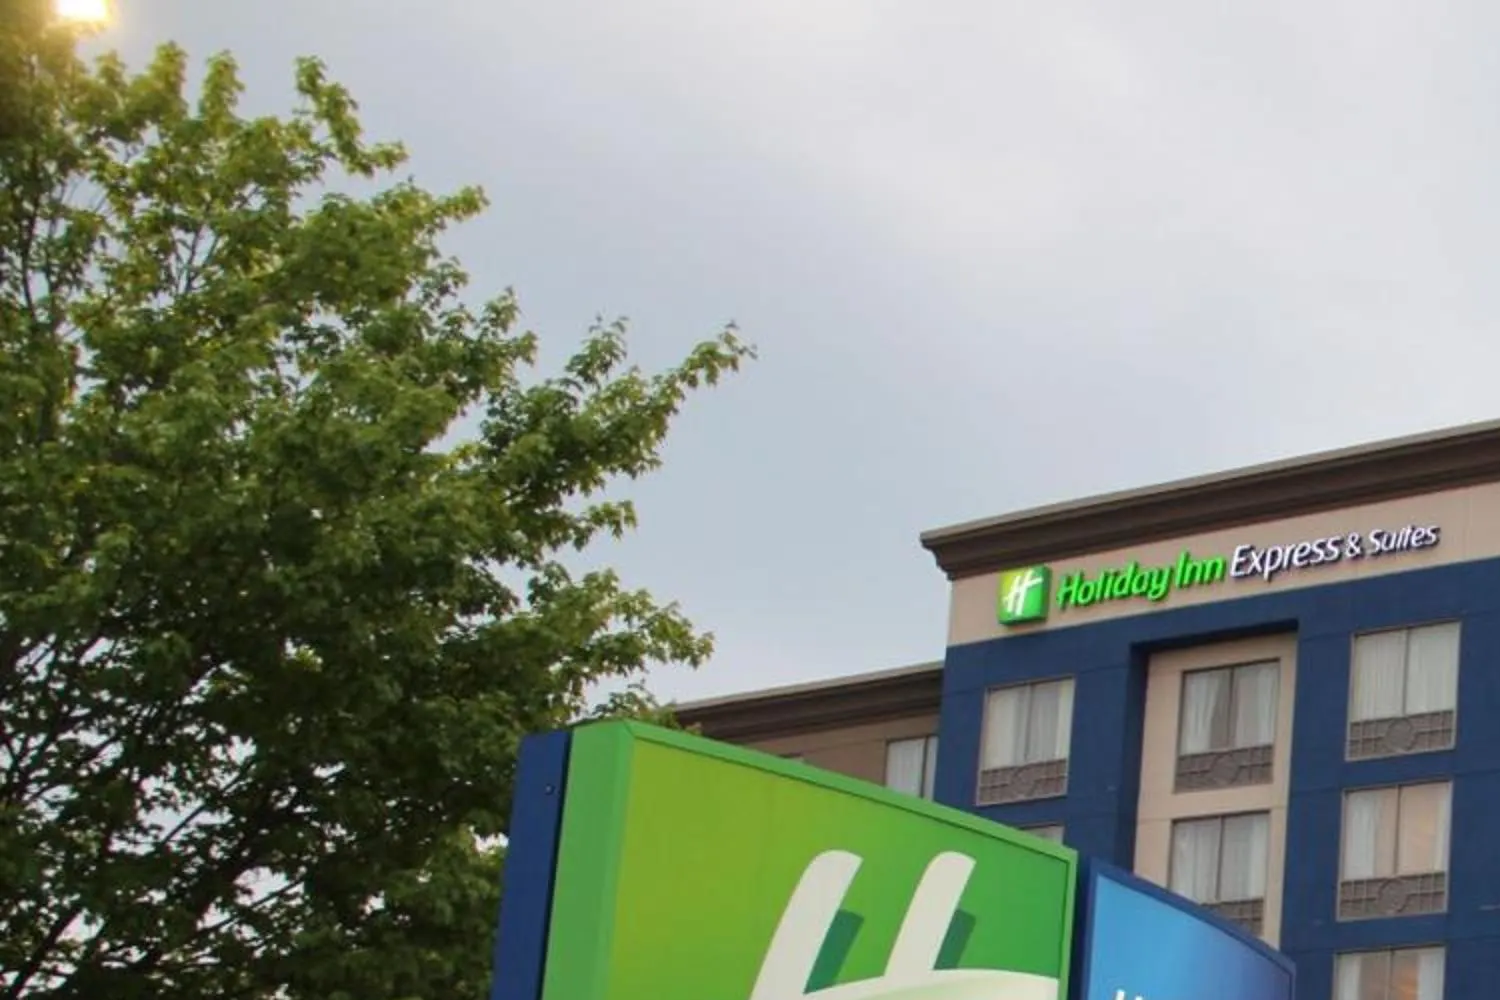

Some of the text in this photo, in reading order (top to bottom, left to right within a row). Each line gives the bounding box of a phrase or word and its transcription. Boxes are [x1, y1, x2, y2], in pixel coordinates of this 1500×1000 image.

[1058, 523, 1438, 610] Holiday Inn Express & Suites
